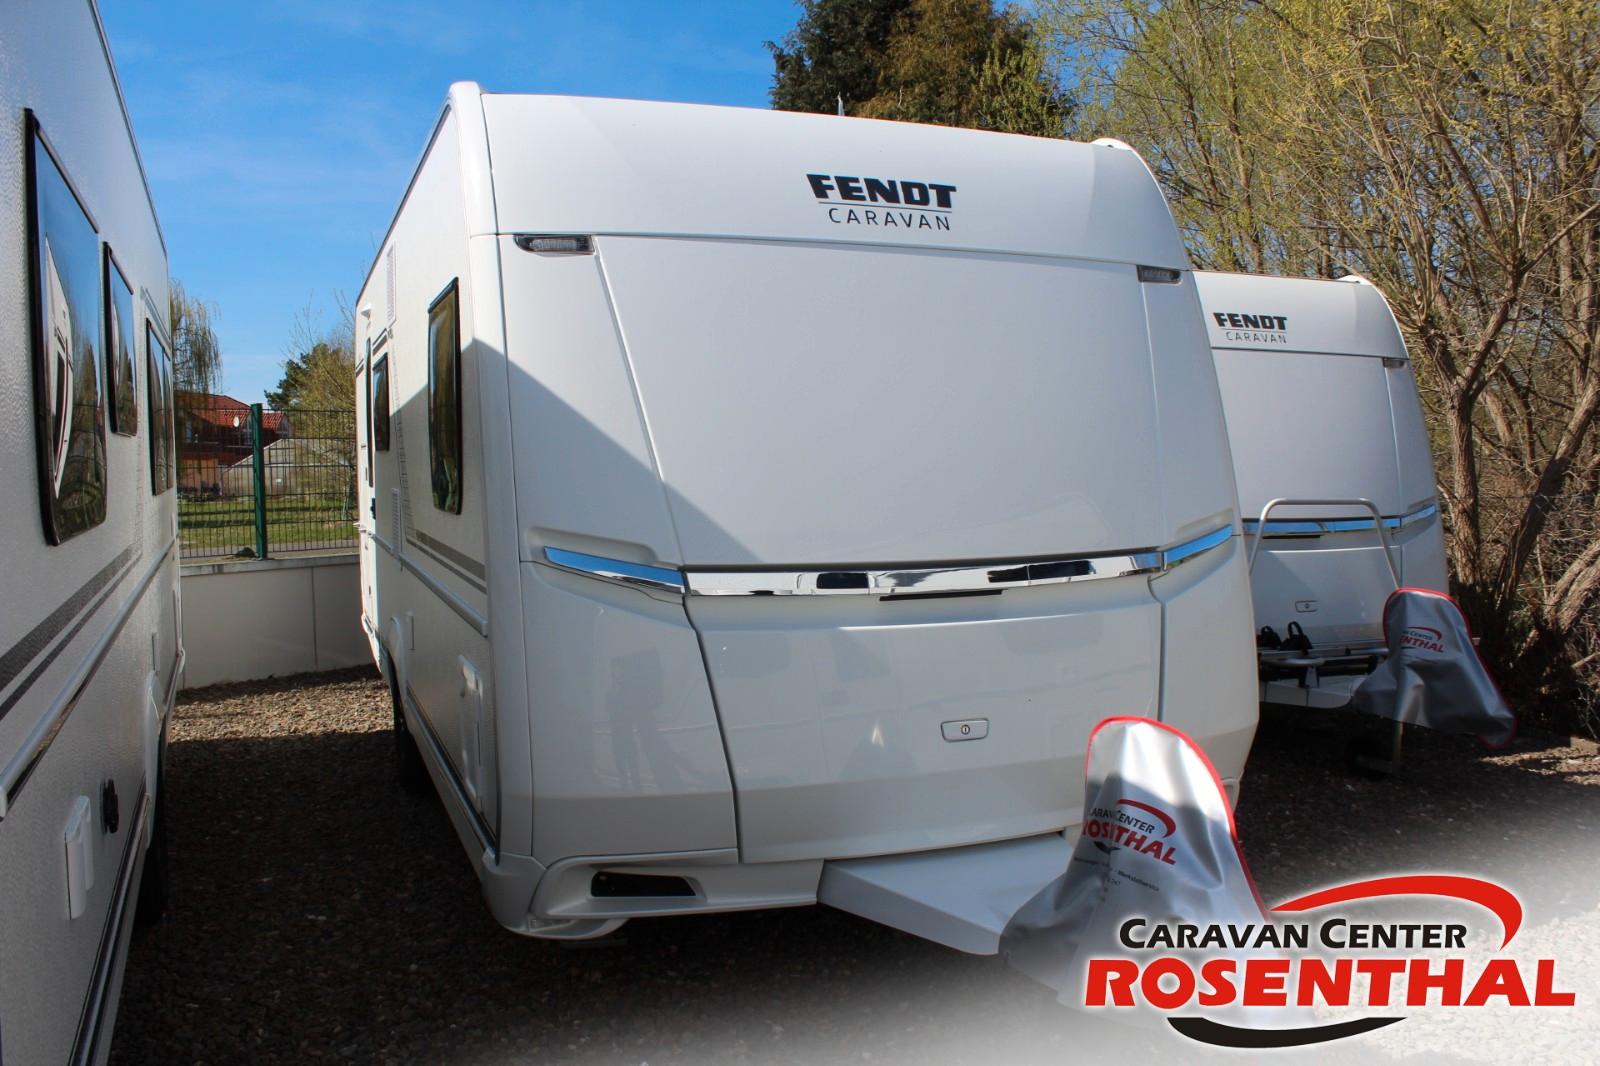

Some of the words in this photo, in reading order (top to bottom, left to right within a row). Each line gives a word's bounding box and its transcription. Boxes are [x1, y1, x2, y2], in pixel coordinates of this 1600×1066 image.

[806, 173, 957, 209] FENDT
[828, 207, 951, 231] CARAVAN
[1213, 312, 1288, 331] FENDT
[1225, 331, 1287, 344] CARAVAN
